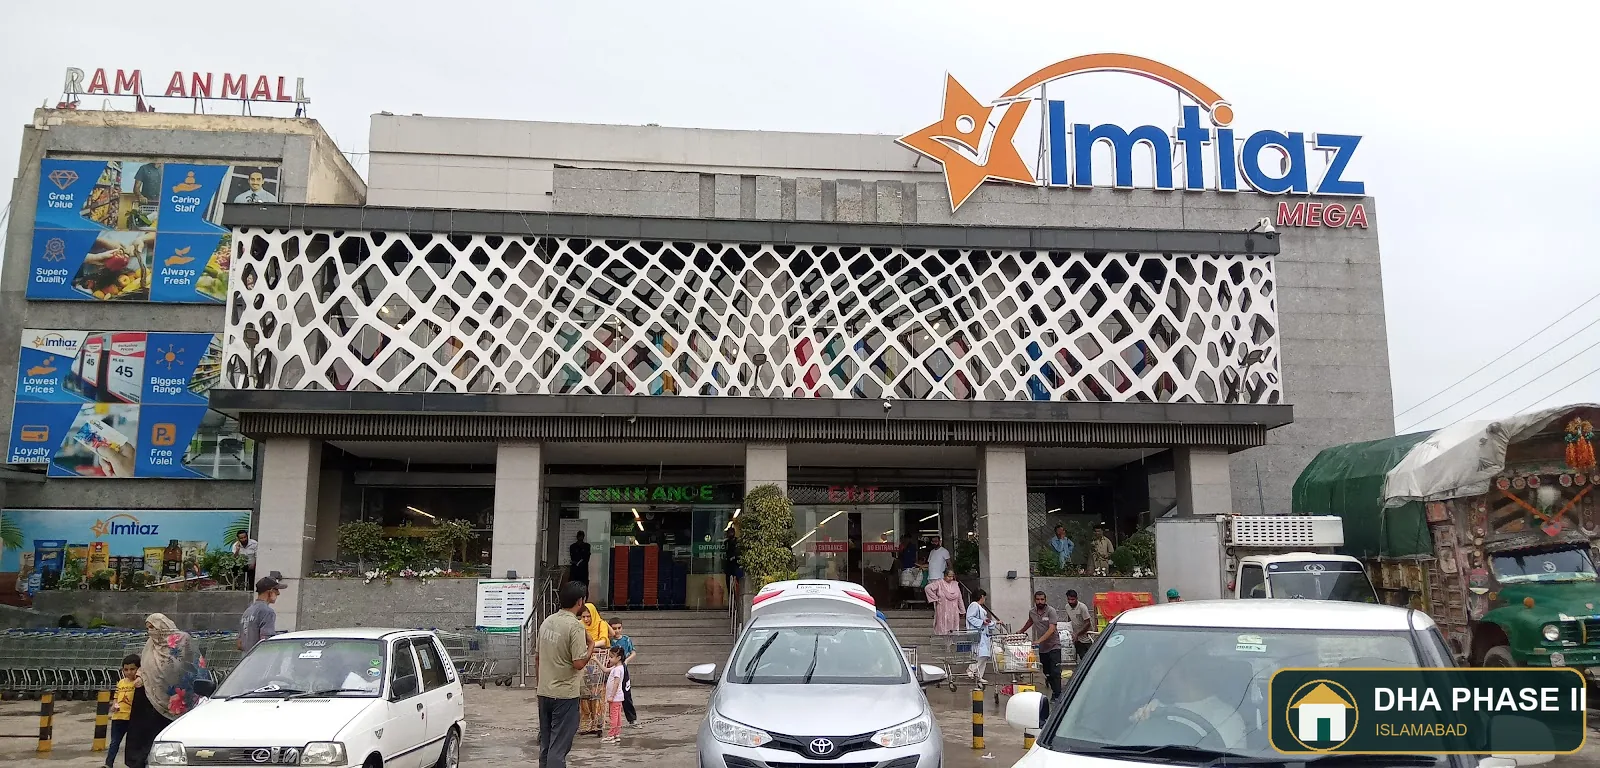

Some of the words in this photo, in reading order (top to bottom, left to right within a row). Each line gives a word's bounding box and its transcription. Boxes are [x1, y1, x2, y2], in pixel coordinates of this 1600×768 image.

[1047, 99, 1366, 196] Imtiaz
[48, 192, 74, 202] Great
[171, 195, 200, 206] Caring
[47, 200, 73, 210] Value
[174, 203, 195, 213] Staff
[1276, 201, 1369, 228] MEGA
[36, 267, 68, 278] Superb
[161, 267, 195, 278] Always
[35, 275, 67, 285] Quality
[163, 276, 190, 286] Fresh
[86, 358, 95, 367] 45
[115, 365, 134, 379] 45
[23, 377, 58, 387] Lowest
[151, 376, 185, 388] Biggest
[24, 385, 55, 394] Prices
[152, 385, 182, 396] Range
[14, 447, 50, 457] Loyalty
[151, 448, 172, 457] Free
[12, 455, 50, 463] Benefits
[150, 457, 173, 465] Valet
[828, 485, 879, 503] EXIT
[110, 521, 159, 536] Imtiaz
[875, 544, 900, 552] ENTRANCE
